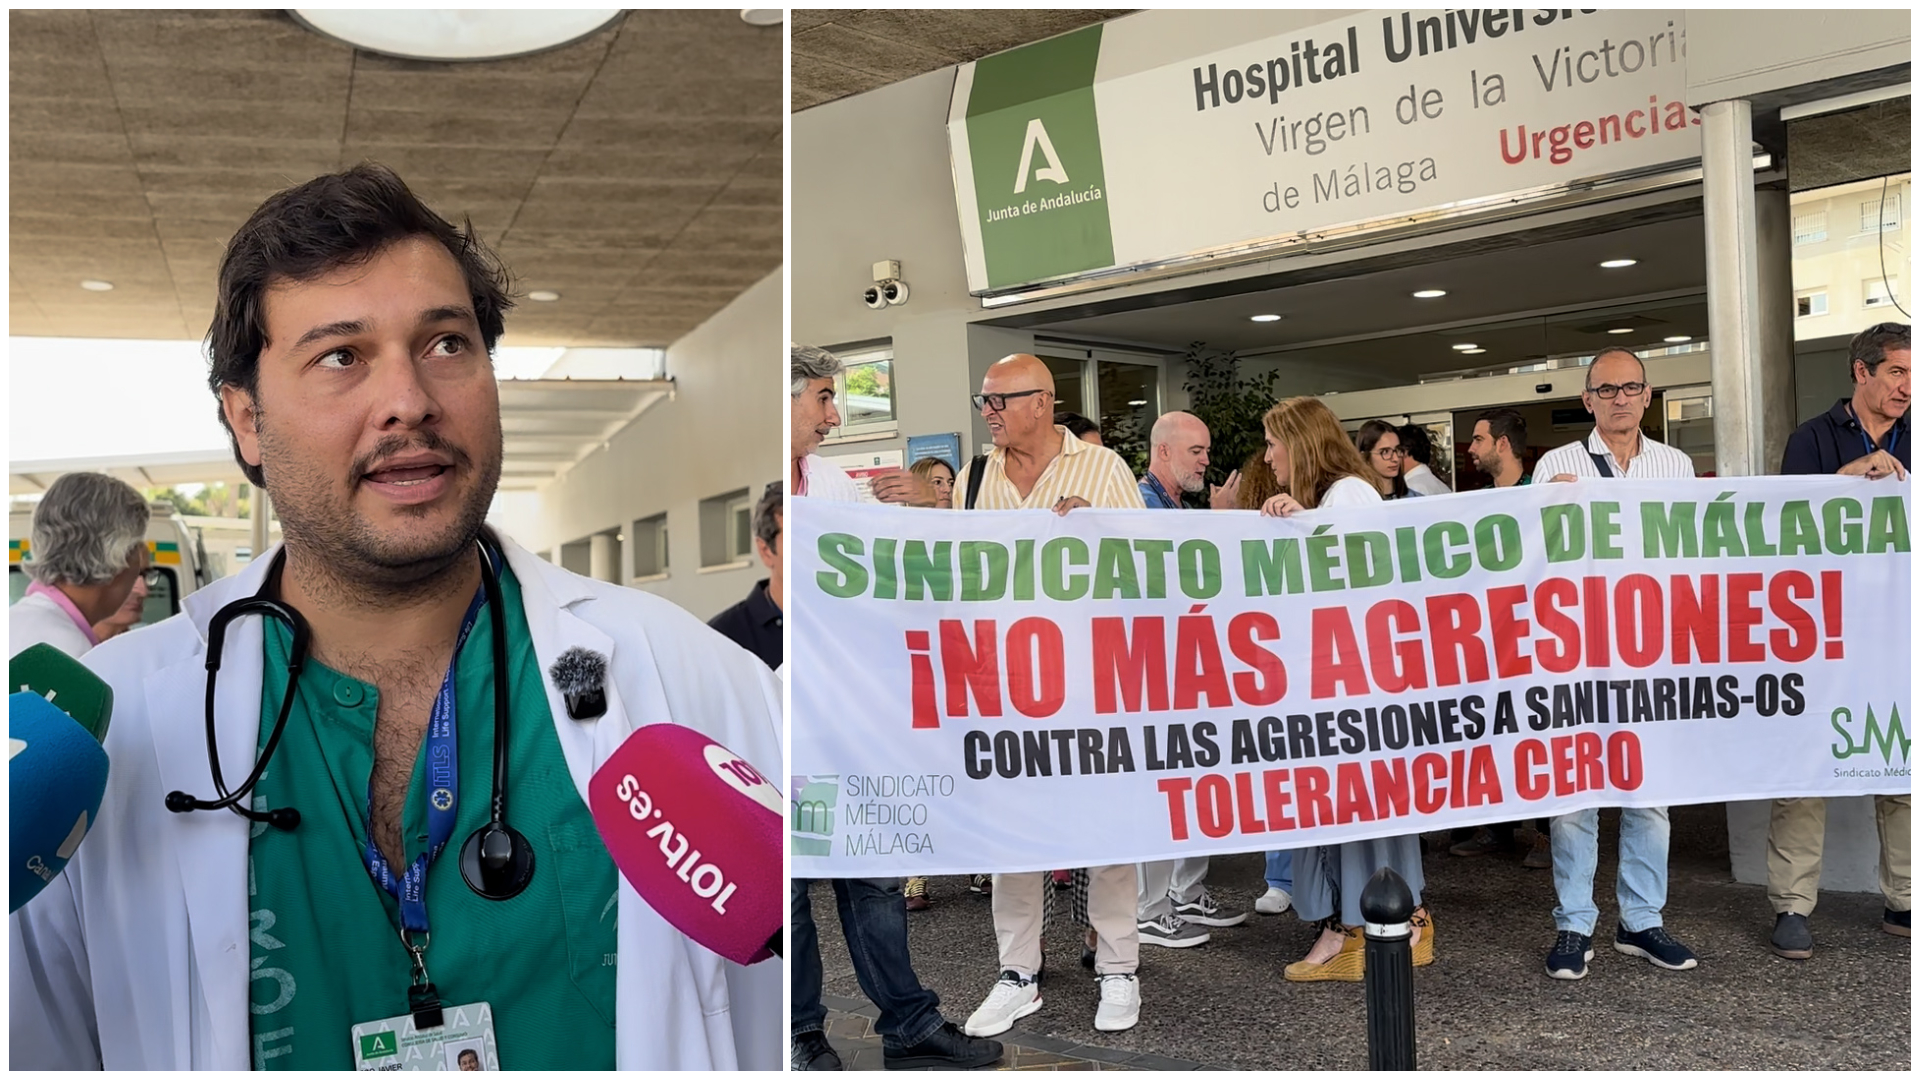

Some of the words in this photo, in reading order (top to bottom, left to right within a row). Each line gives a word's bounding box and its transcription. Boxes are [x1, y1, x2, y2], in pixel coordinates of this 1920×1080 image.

[1193, 26, 1361, 112] Hospital
[1255, 105, 1370, 156] Virgen
[1395, 84, 1444, 125] de
[1470, 70, 1507, 109] la
[1532, 20, 1686, 92] Victori
[986, 205, 1020, 222] Junta
[1022, 200, 1037, 215] de
[1039, 184, 1102, 211] Andalucía
[1263, 181, 1301, 214] de
[1312, 156, 1439, 204] Málaga
[815, 532, 1222, 602] SINDICATO
[1241, 513, 1523, 597] MÉDICO
[1540, 501, 1624, 563] DE
[1640, 491, 1911, 560] MÁLAGA
[905, 616, 1066, 728] ¡NO
[1090, 603, 1288, 715] MÁS
[1310, 569, 1844, 699] AGRESIONES!
[441, 688, 451, 720] Support
[441, 721, 450, 737] Life
[963, 726, 1135, 780] CONTRA
[1143, 721, 1221, 771] LAS
[1231, 694, 1486, 762] AGRESIONES
[1492, 690, 1519, 736] A
[1527, 672, 1806, 732] SANITARIAS-OS
[433, 744, 450, 787] ITLS
[846, 774, 955, 798] SINDICATO
[1157, 743, 1504, 841] TOLERANCIA
[1513, 730, 1644, 801] CERO
[1833, 767, 1881, 778] Sindicato
[845, 799, 928, 826] MÉDICO
[616, 774, 738, 915] 101tv.es
[845, 828, 935, 857] MÁLAGA
[411, 885, 420, 902] Life
